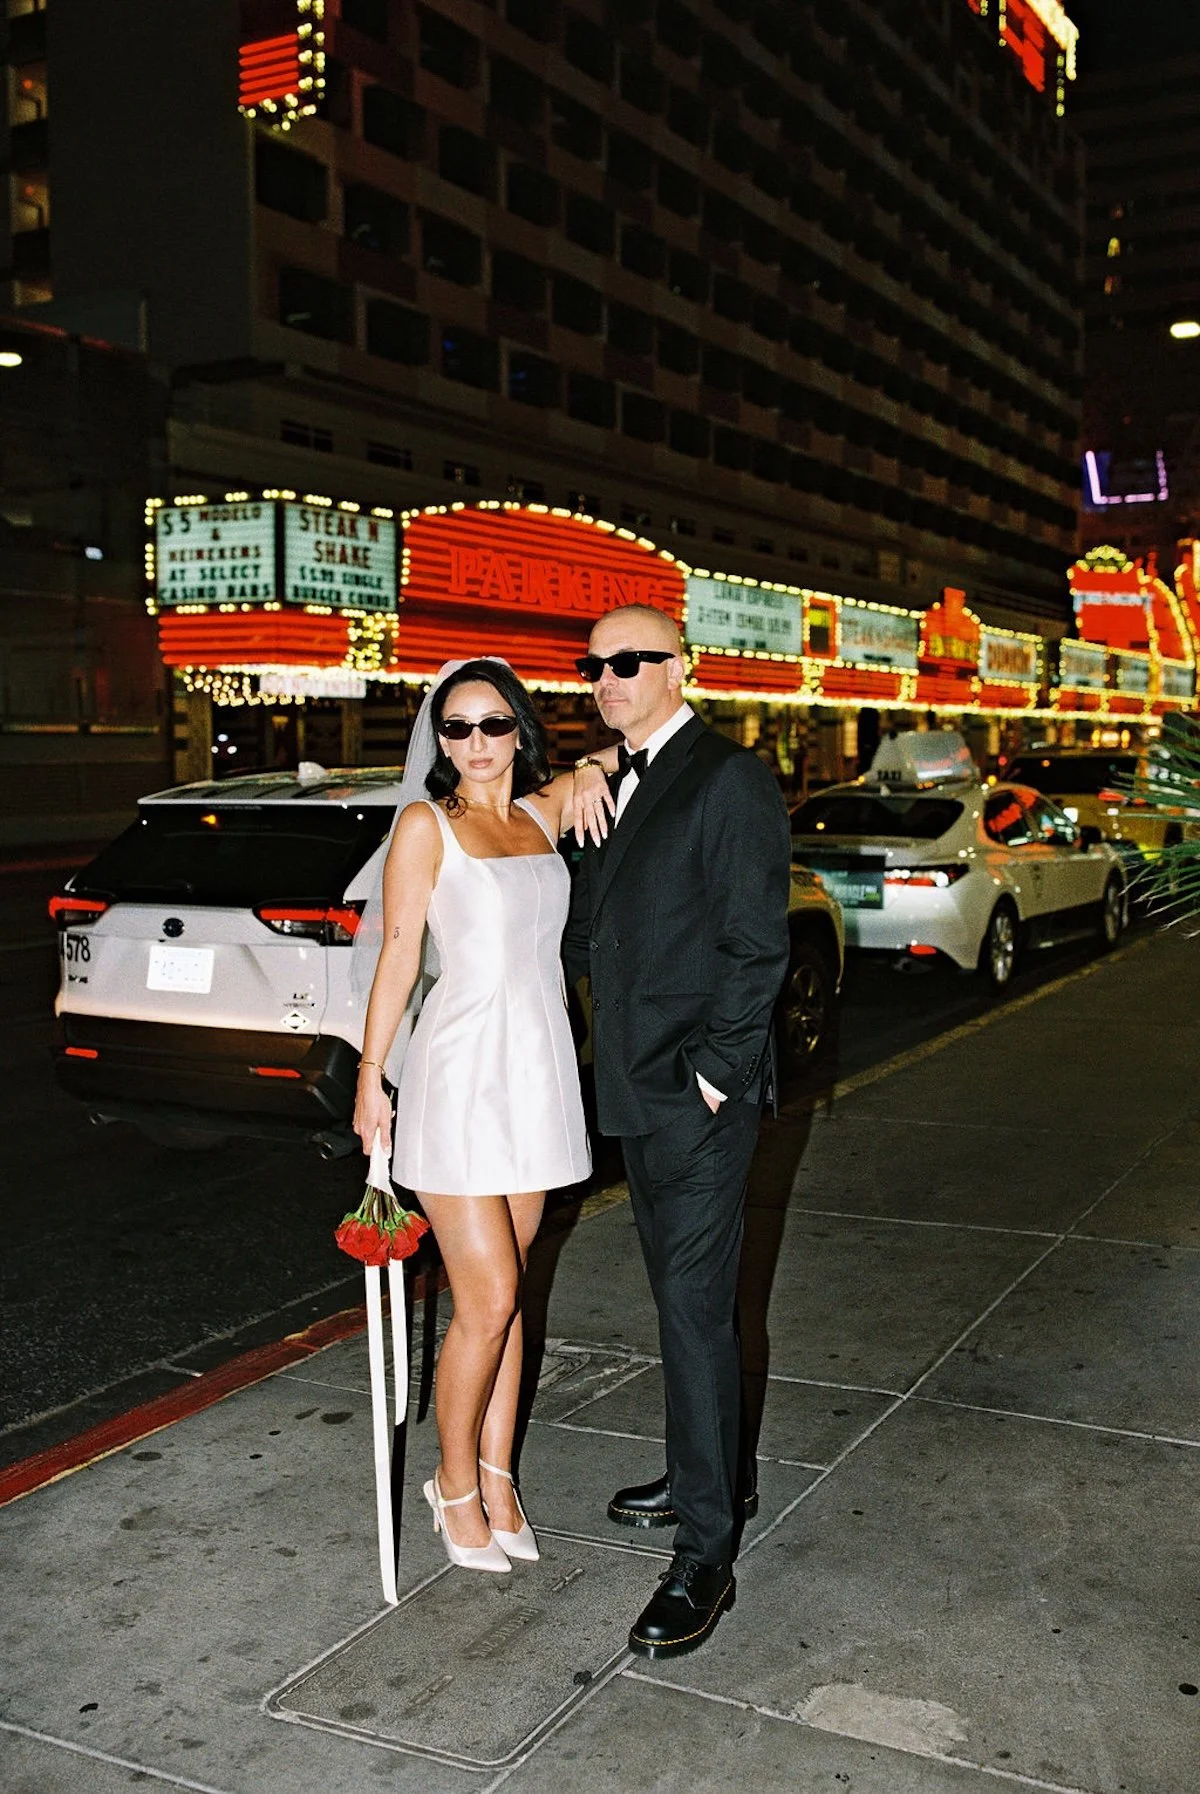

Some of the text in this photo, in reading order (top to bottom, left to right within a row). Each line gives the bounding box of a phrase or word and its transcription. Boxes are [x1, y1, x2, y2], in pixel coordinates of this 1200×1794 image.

[299, 508, 360, 540] STEAK
[314, 540, 372, 570] SHAKE
[168, 565, 261, 582] AT SELECT
[449, 546, 664, 612] PARKING
[158, 583, 271, 602] CASINO BARS
[348, 591, 390, 608] COMBO
